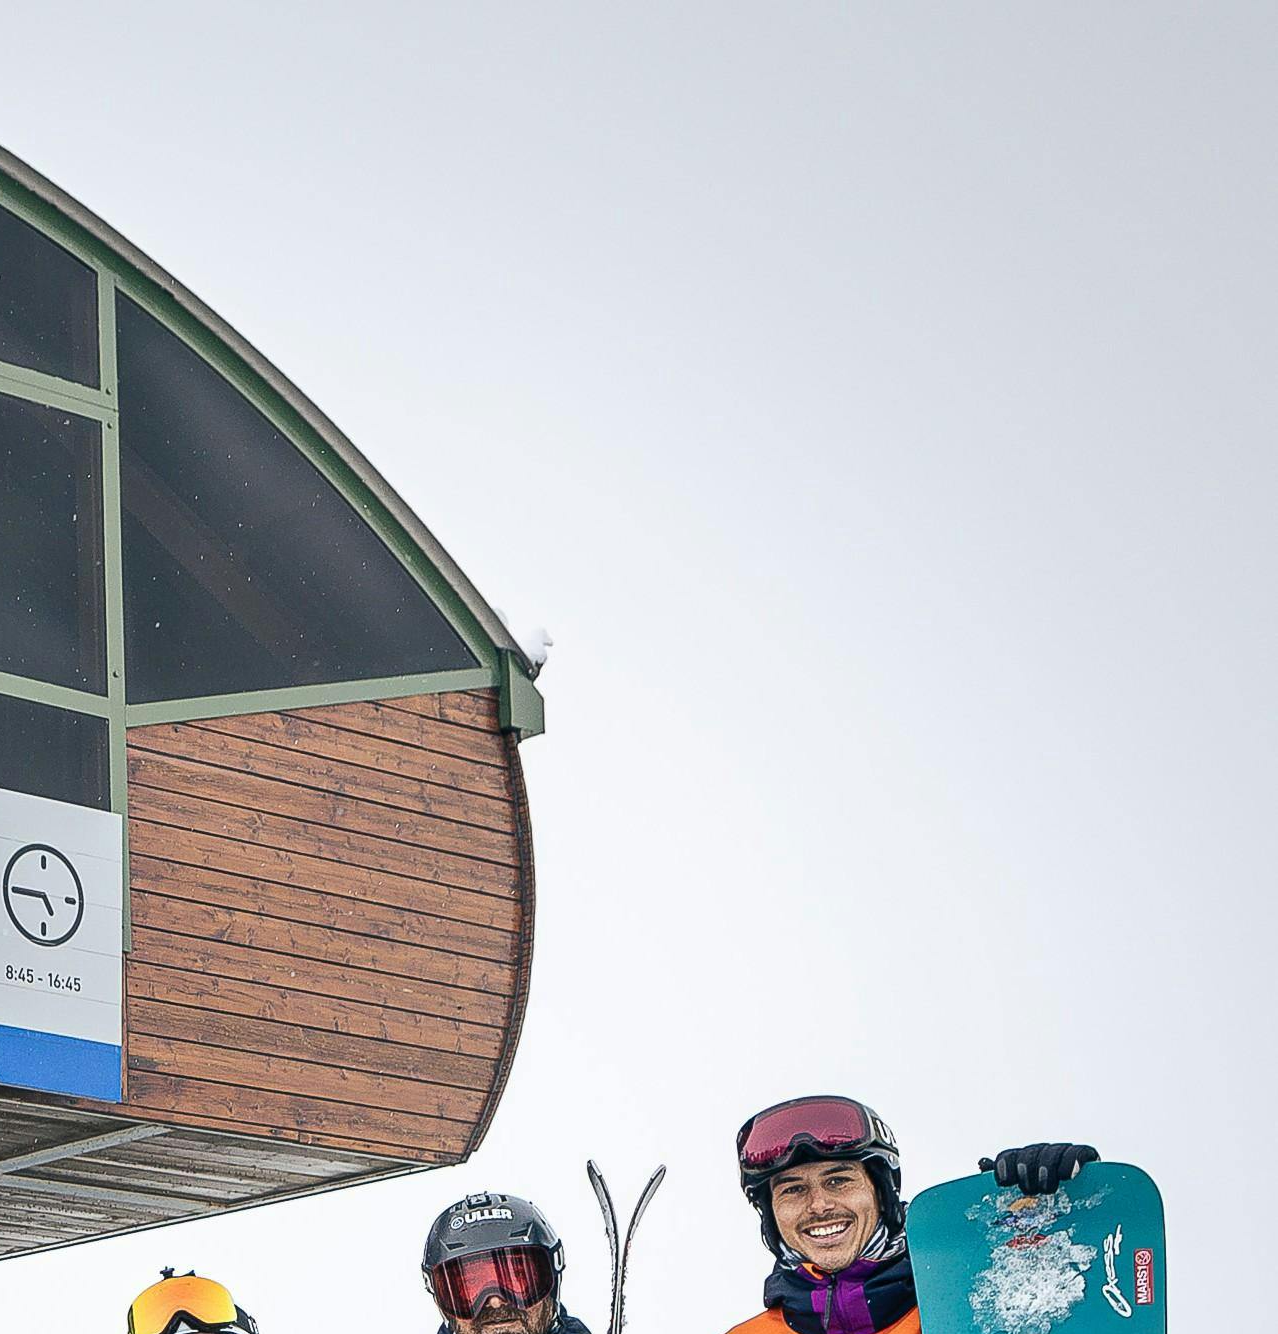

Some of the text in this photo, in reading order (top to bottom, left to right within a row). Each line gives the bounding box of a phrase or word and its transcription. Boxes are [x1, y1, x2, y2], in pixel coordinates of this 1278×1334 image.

[5, 964, 34, 984] 8:45
[47, 972, 82, 992] 16:45
[464, 1208, 513, 1224] ULLER
